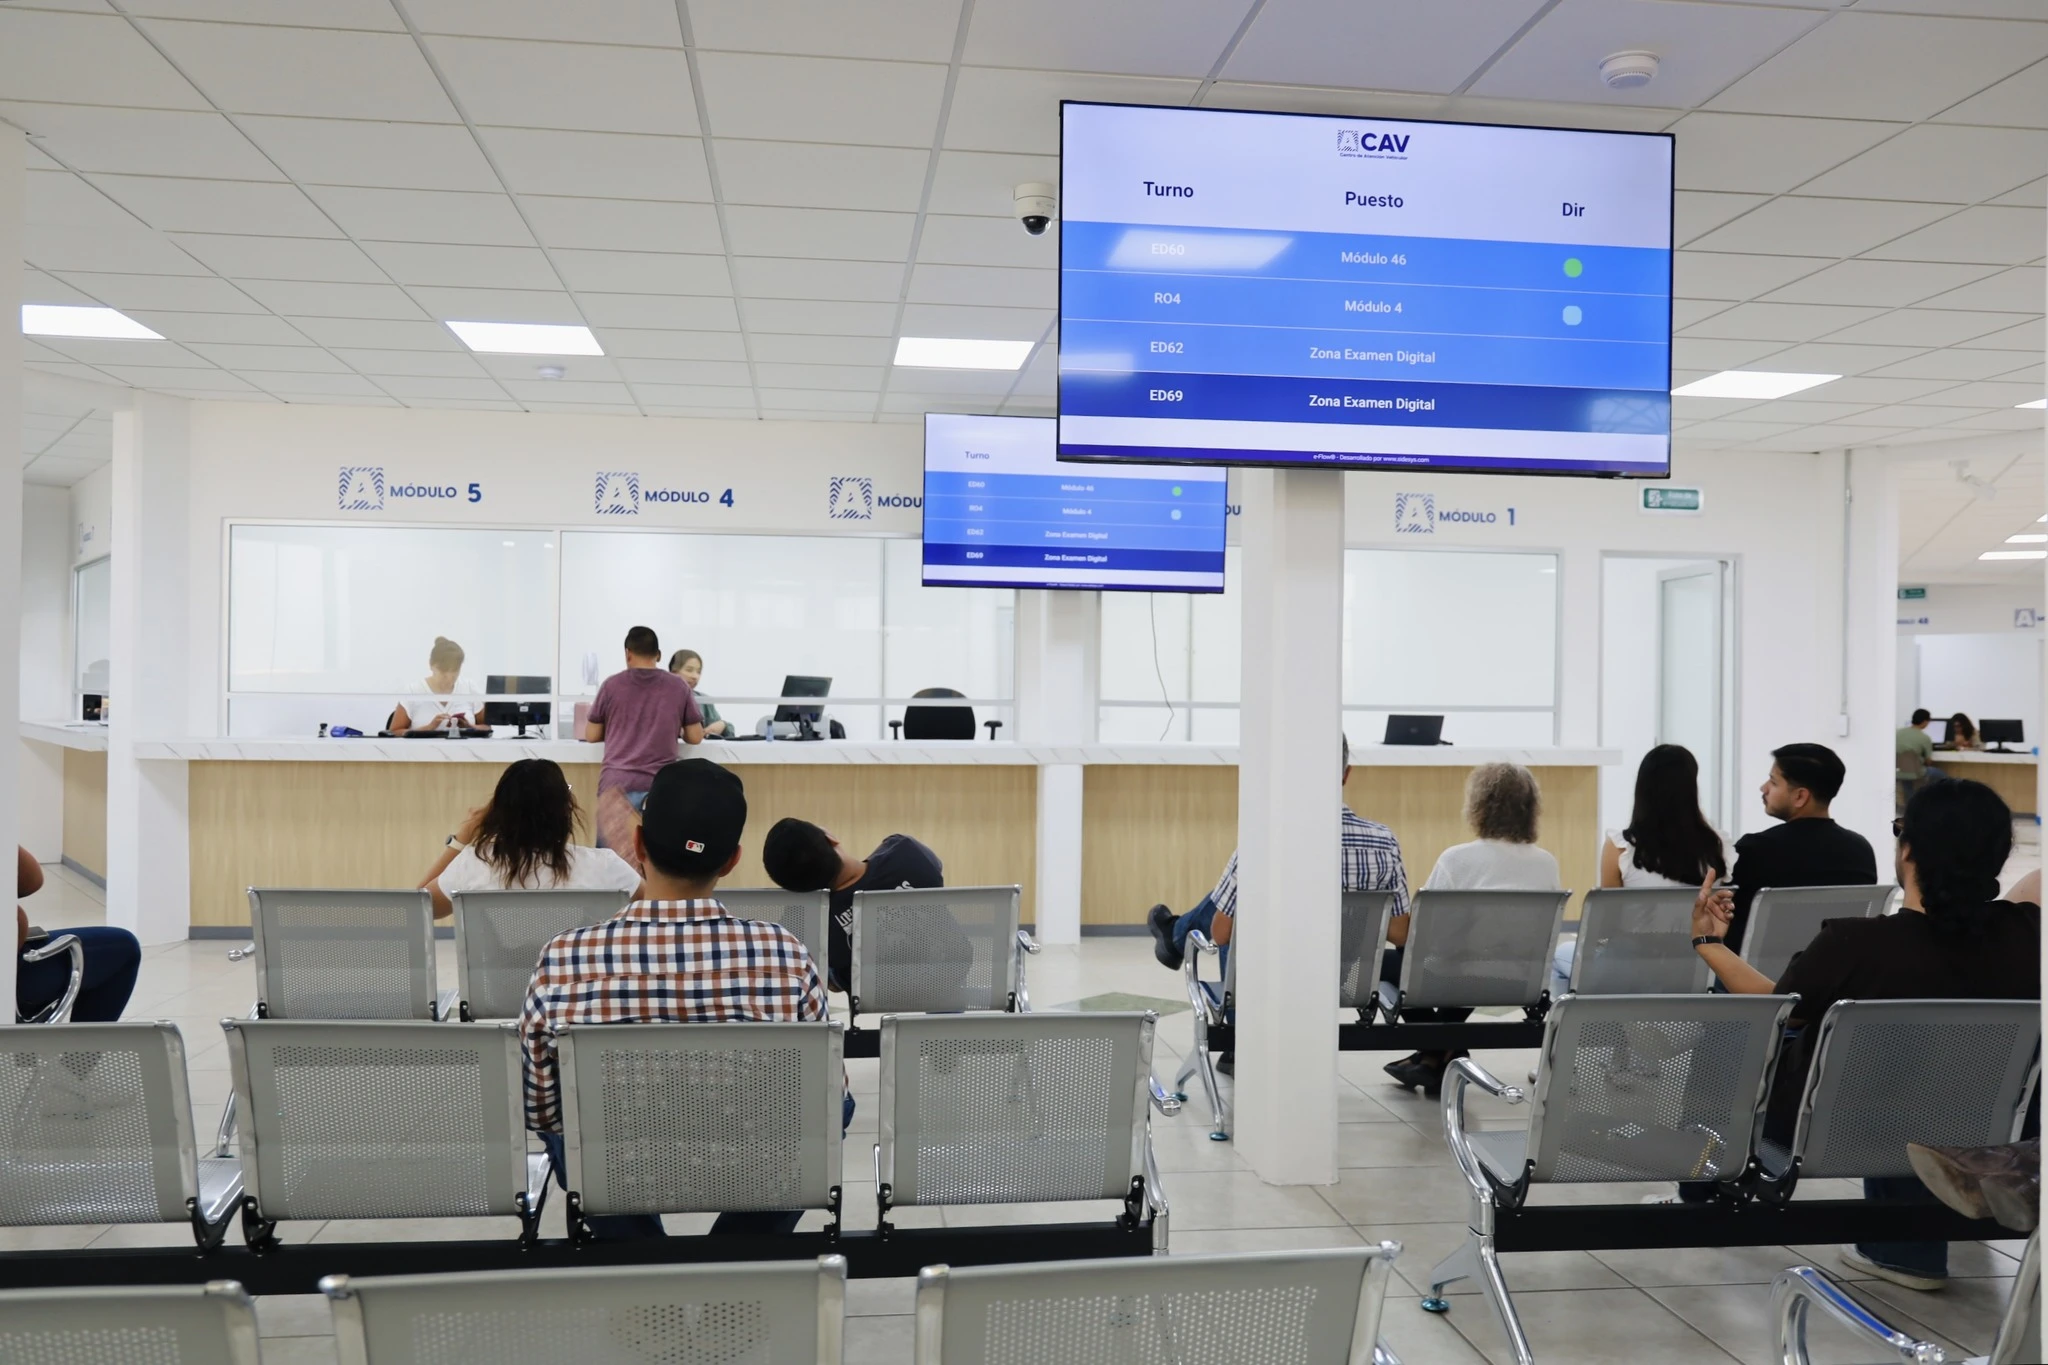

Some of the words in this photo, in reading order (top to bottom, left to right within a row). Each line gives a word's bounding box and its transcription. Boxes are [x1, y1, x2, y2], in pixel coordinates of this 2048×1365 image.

[1360, 132, 1411, 153] CAV
[1143, 181, 1194, 198] Turno
[1345, 191, 1404, 208] Puesto
[1562, 202, 1586, 217] Dir
[1151, 243, 1185, 255] ED60
[1341, 251, 1388, 264] Módulo
[1391, 253, 1407, 265] 46
[1344, 300, 1391, 313] Módulo
[1394, 302, 1403, 313] 4
[1150, 341, 1184, 354] ED62
[1309, 347, 1341, 359] Zona
[1344, 348, 1394, 361] Examen
[1396, 351, 1436, 365] Digital
[1149, 389, 1184, 401] ED69
[1309, 395, 1341, 407] Zona
[1343, 396, 1393, 409] Examen
[1395, 398, 1435, 412] Digital
[965, 451, 990, 459] Turno
[389, 482, 457, 498] MÓDULO
[467, 483, 482, 503] 5
[644, 488, 710, 503] MÓDULO
[719, 488, 734, 508] 4
[877, 493, 923, 508] MÓDU
[1439, 508, 1497, 523] MÓDULO
[1506, 507, 1515, 526] 1
